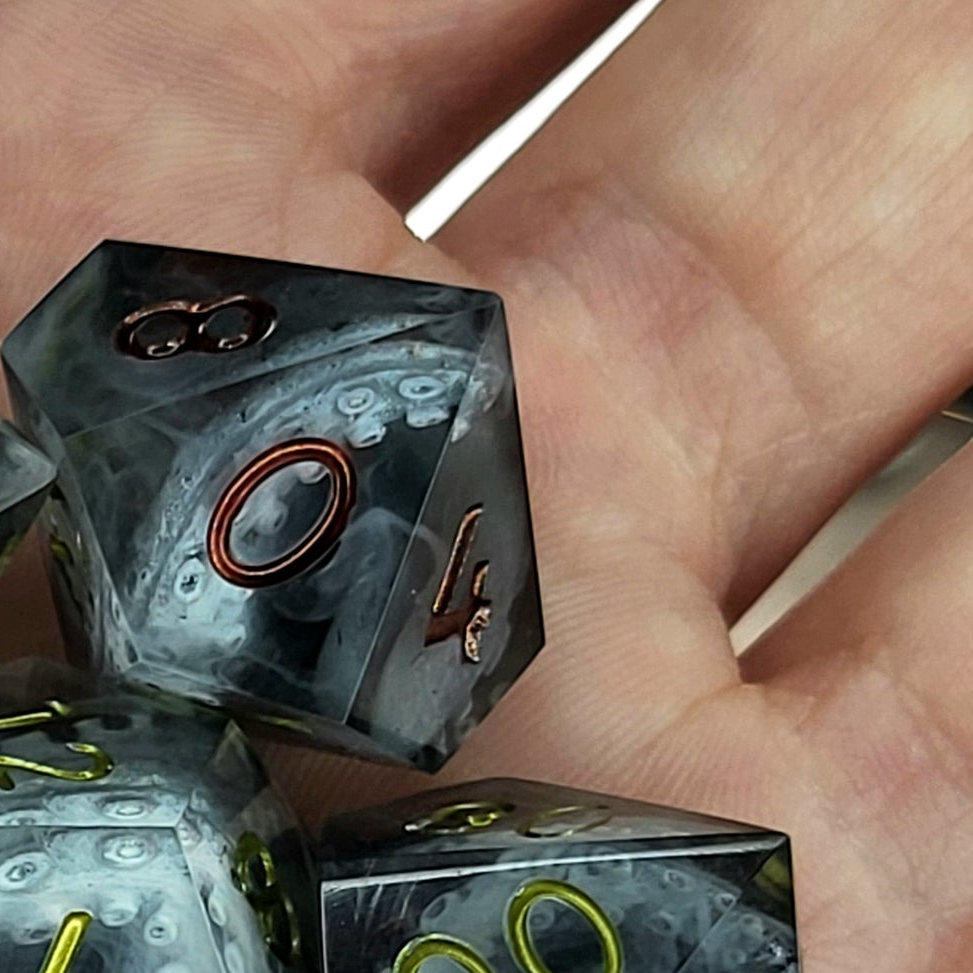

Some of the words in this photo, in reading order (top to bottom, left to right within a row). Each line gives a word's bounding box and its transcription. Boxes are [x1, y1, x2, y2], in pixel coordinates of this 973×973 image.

[114, 295, 277, 361] 8
[207, 437, 358, 590] 0
[425, 504, 491, 664] 4
